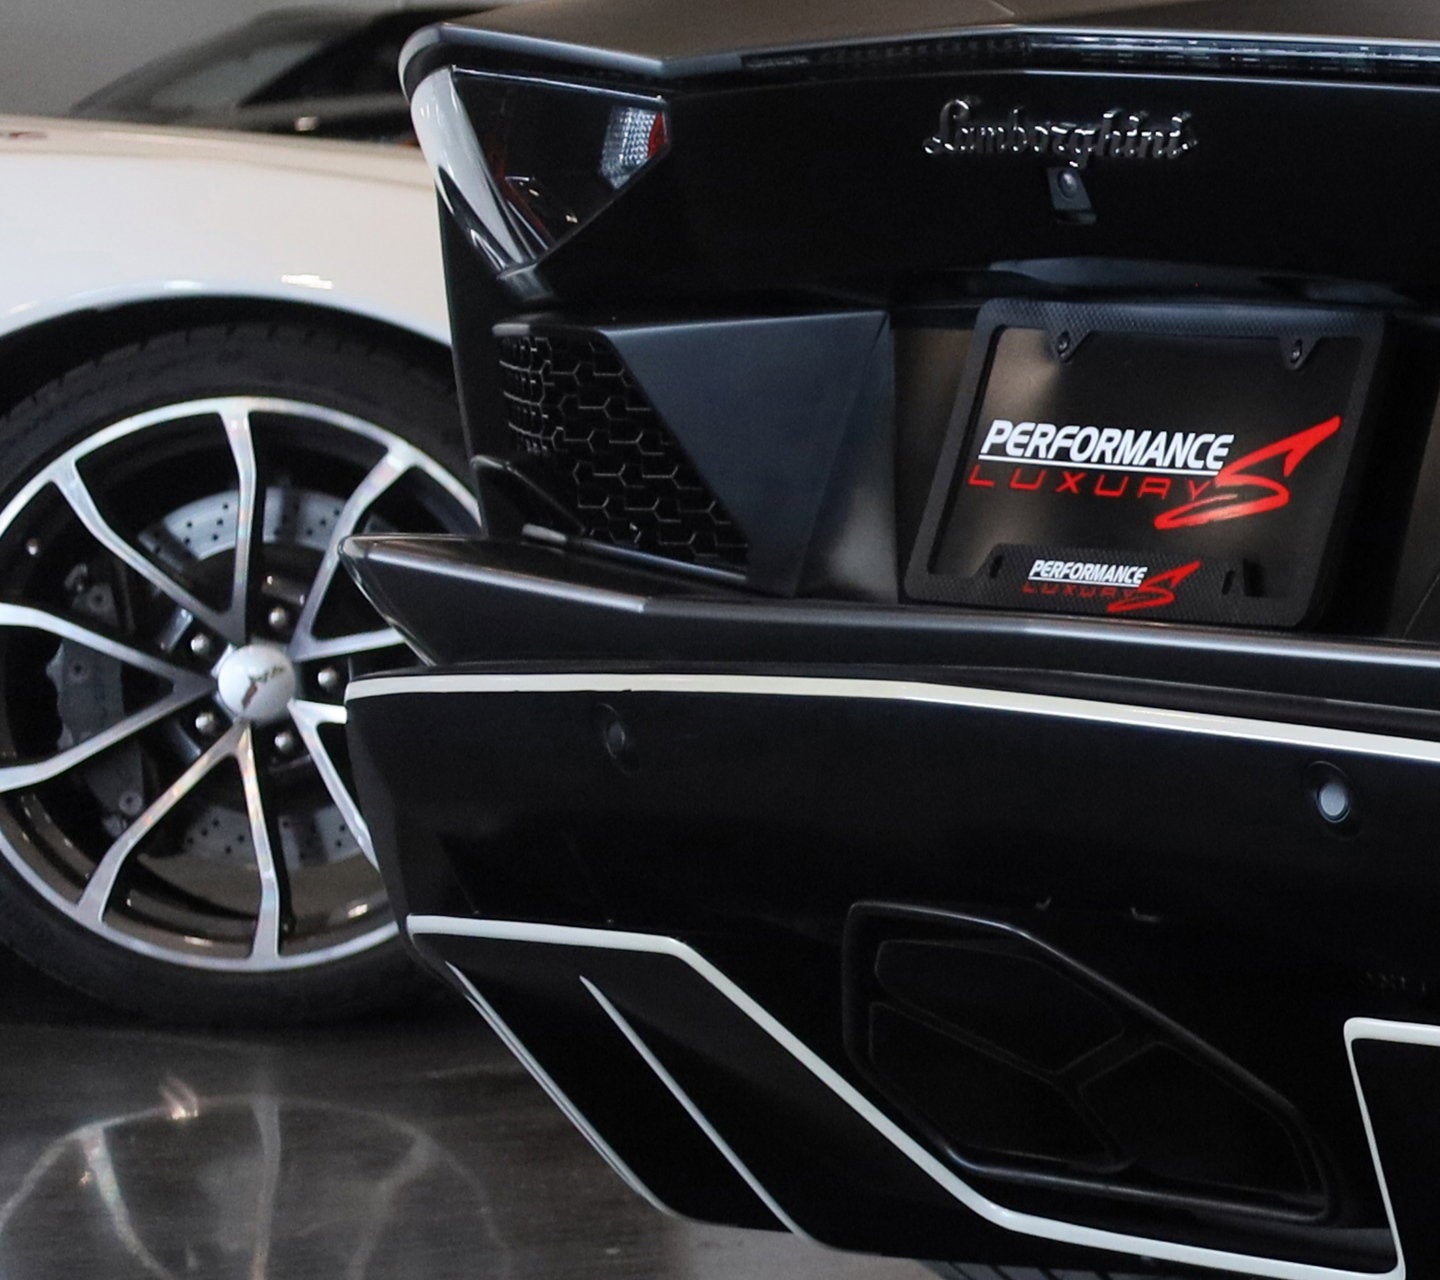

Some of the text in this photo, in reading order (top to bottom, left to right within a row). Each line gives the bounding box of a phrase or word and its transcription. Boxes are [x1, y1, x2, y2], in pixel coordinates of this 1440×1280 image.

[921, 95, 1199, 169] Lamborghini
[979, 419, 1235, 471] PERFORMANCE
[967, 465, 1214, 501] LUXURY
[1021, 581, 1137, 598] LUXURY
[1028, 559, 1149, 584] PERFORMANCE
